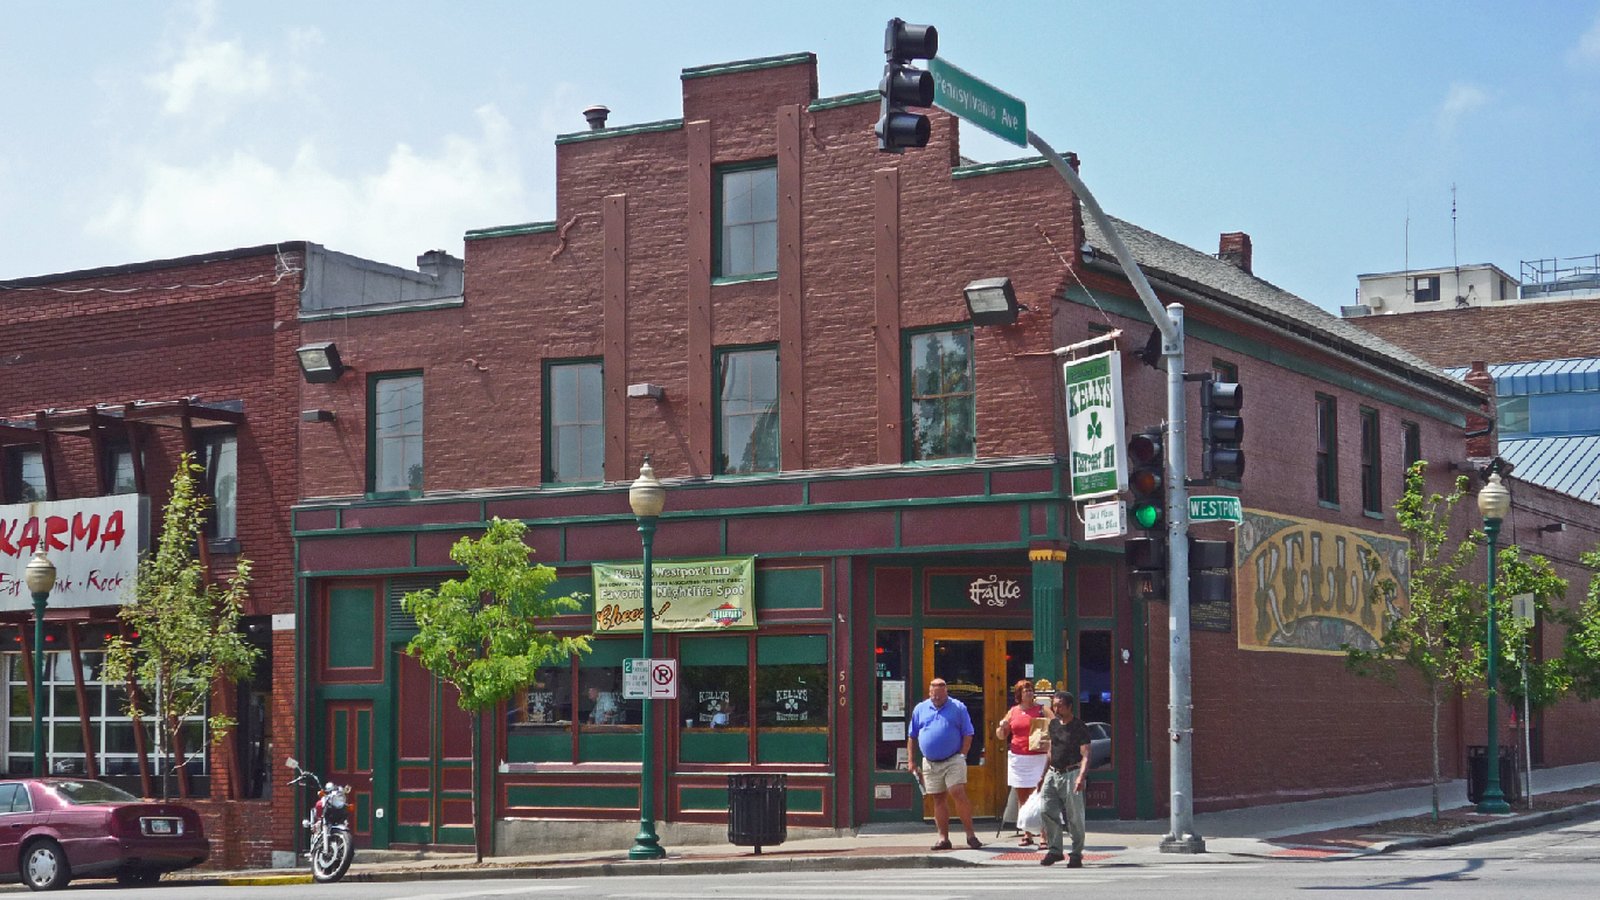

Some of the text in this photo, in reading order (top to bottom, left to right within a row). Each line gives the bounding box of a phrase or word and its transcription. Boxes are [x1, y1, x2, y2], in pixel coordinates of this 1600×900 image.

[1001, 108, 1019, 131] Ave
[1069, 377, 1112, 418] KELLYS
[1190, 500, 1241, 517] WESTPOR
[0, 510, 125, 559] KARMA
[654, 566, 706, 579] Westport
[709, 566, 730, 576] Inn
[0, 572, 24, 597] Eat
[86, 569, 124, 593] Rock
[600, 583, 745, 601] Favorit Nightlife Spot
[625, 662, 632, 672] 2
[699, 691, 730, 704] KELLYS
[776, 689, 808, 703] KELLYS
